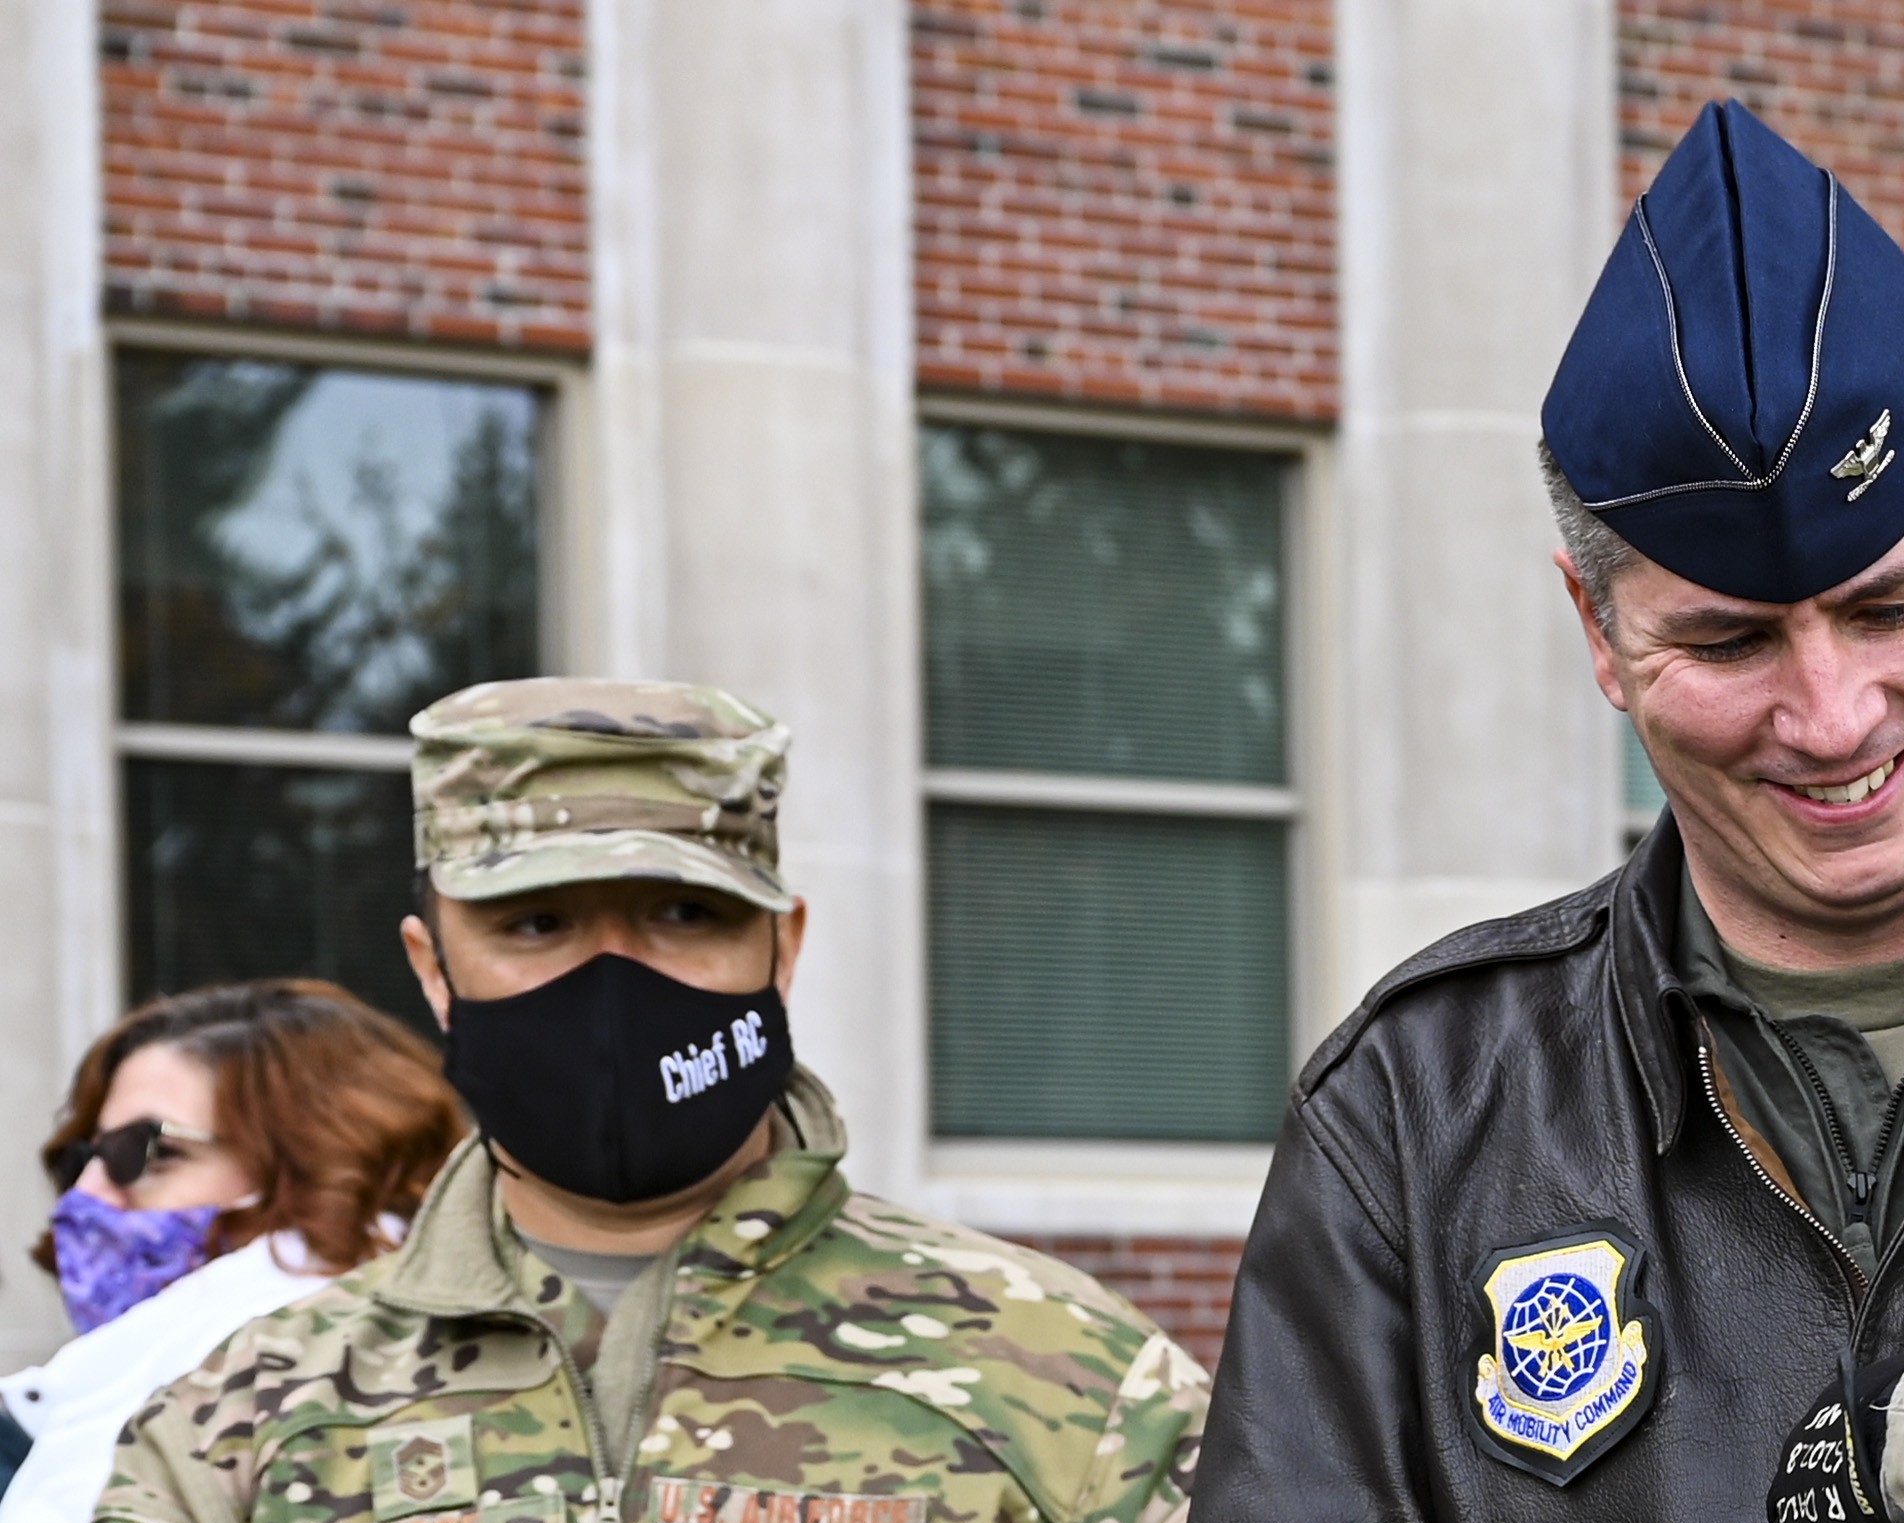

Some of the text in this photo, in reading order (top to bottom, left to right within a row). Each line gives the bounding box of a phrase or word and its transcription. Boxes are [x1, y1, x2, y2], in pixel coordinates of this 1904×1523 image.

[659, 1010, 768, 1103] Chief RC
[1488, 1361, 1638, 1445] AIR MOBILITY COMMAND
